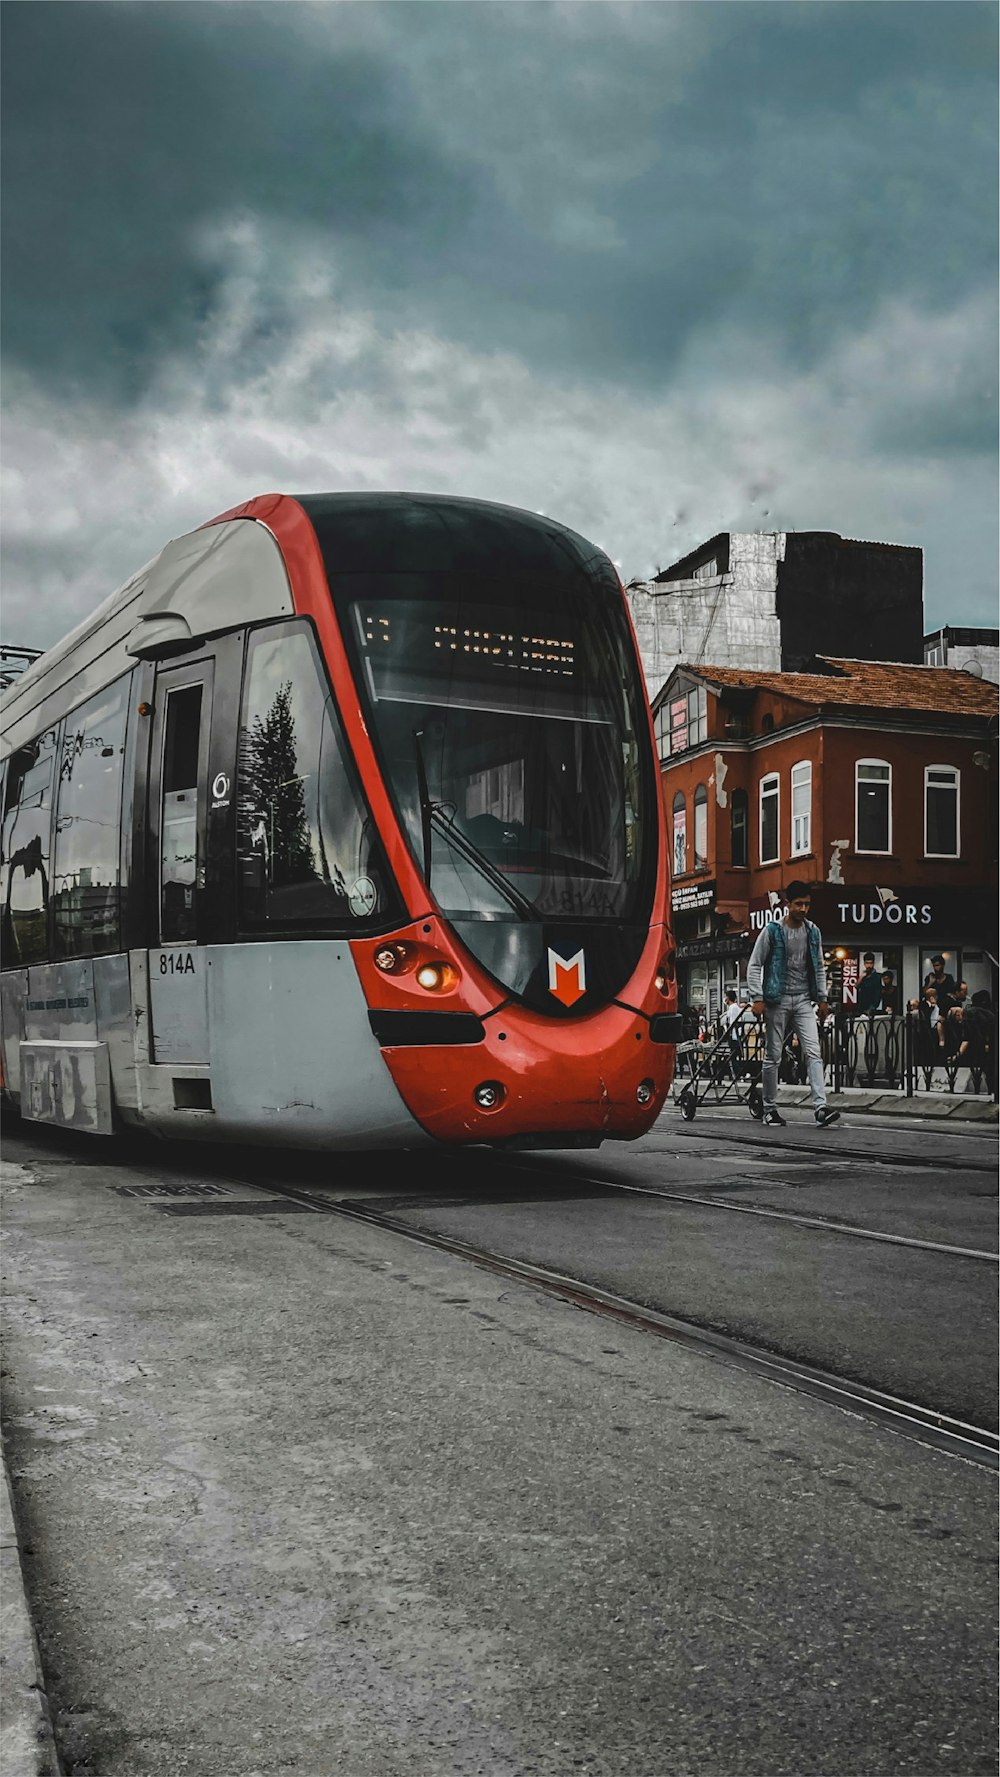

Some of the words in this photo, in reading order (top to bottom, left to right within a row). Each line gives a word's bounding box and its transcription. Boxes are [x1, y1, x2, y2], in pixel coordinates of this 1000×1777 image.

[838, 904, 932, 924] TUDORS
[160, 953, 195, 974] 814A
[842, 966, 858, 977] SE
[842, 977, 858, 987] ZO
[842, 986, 858, 1004] N
